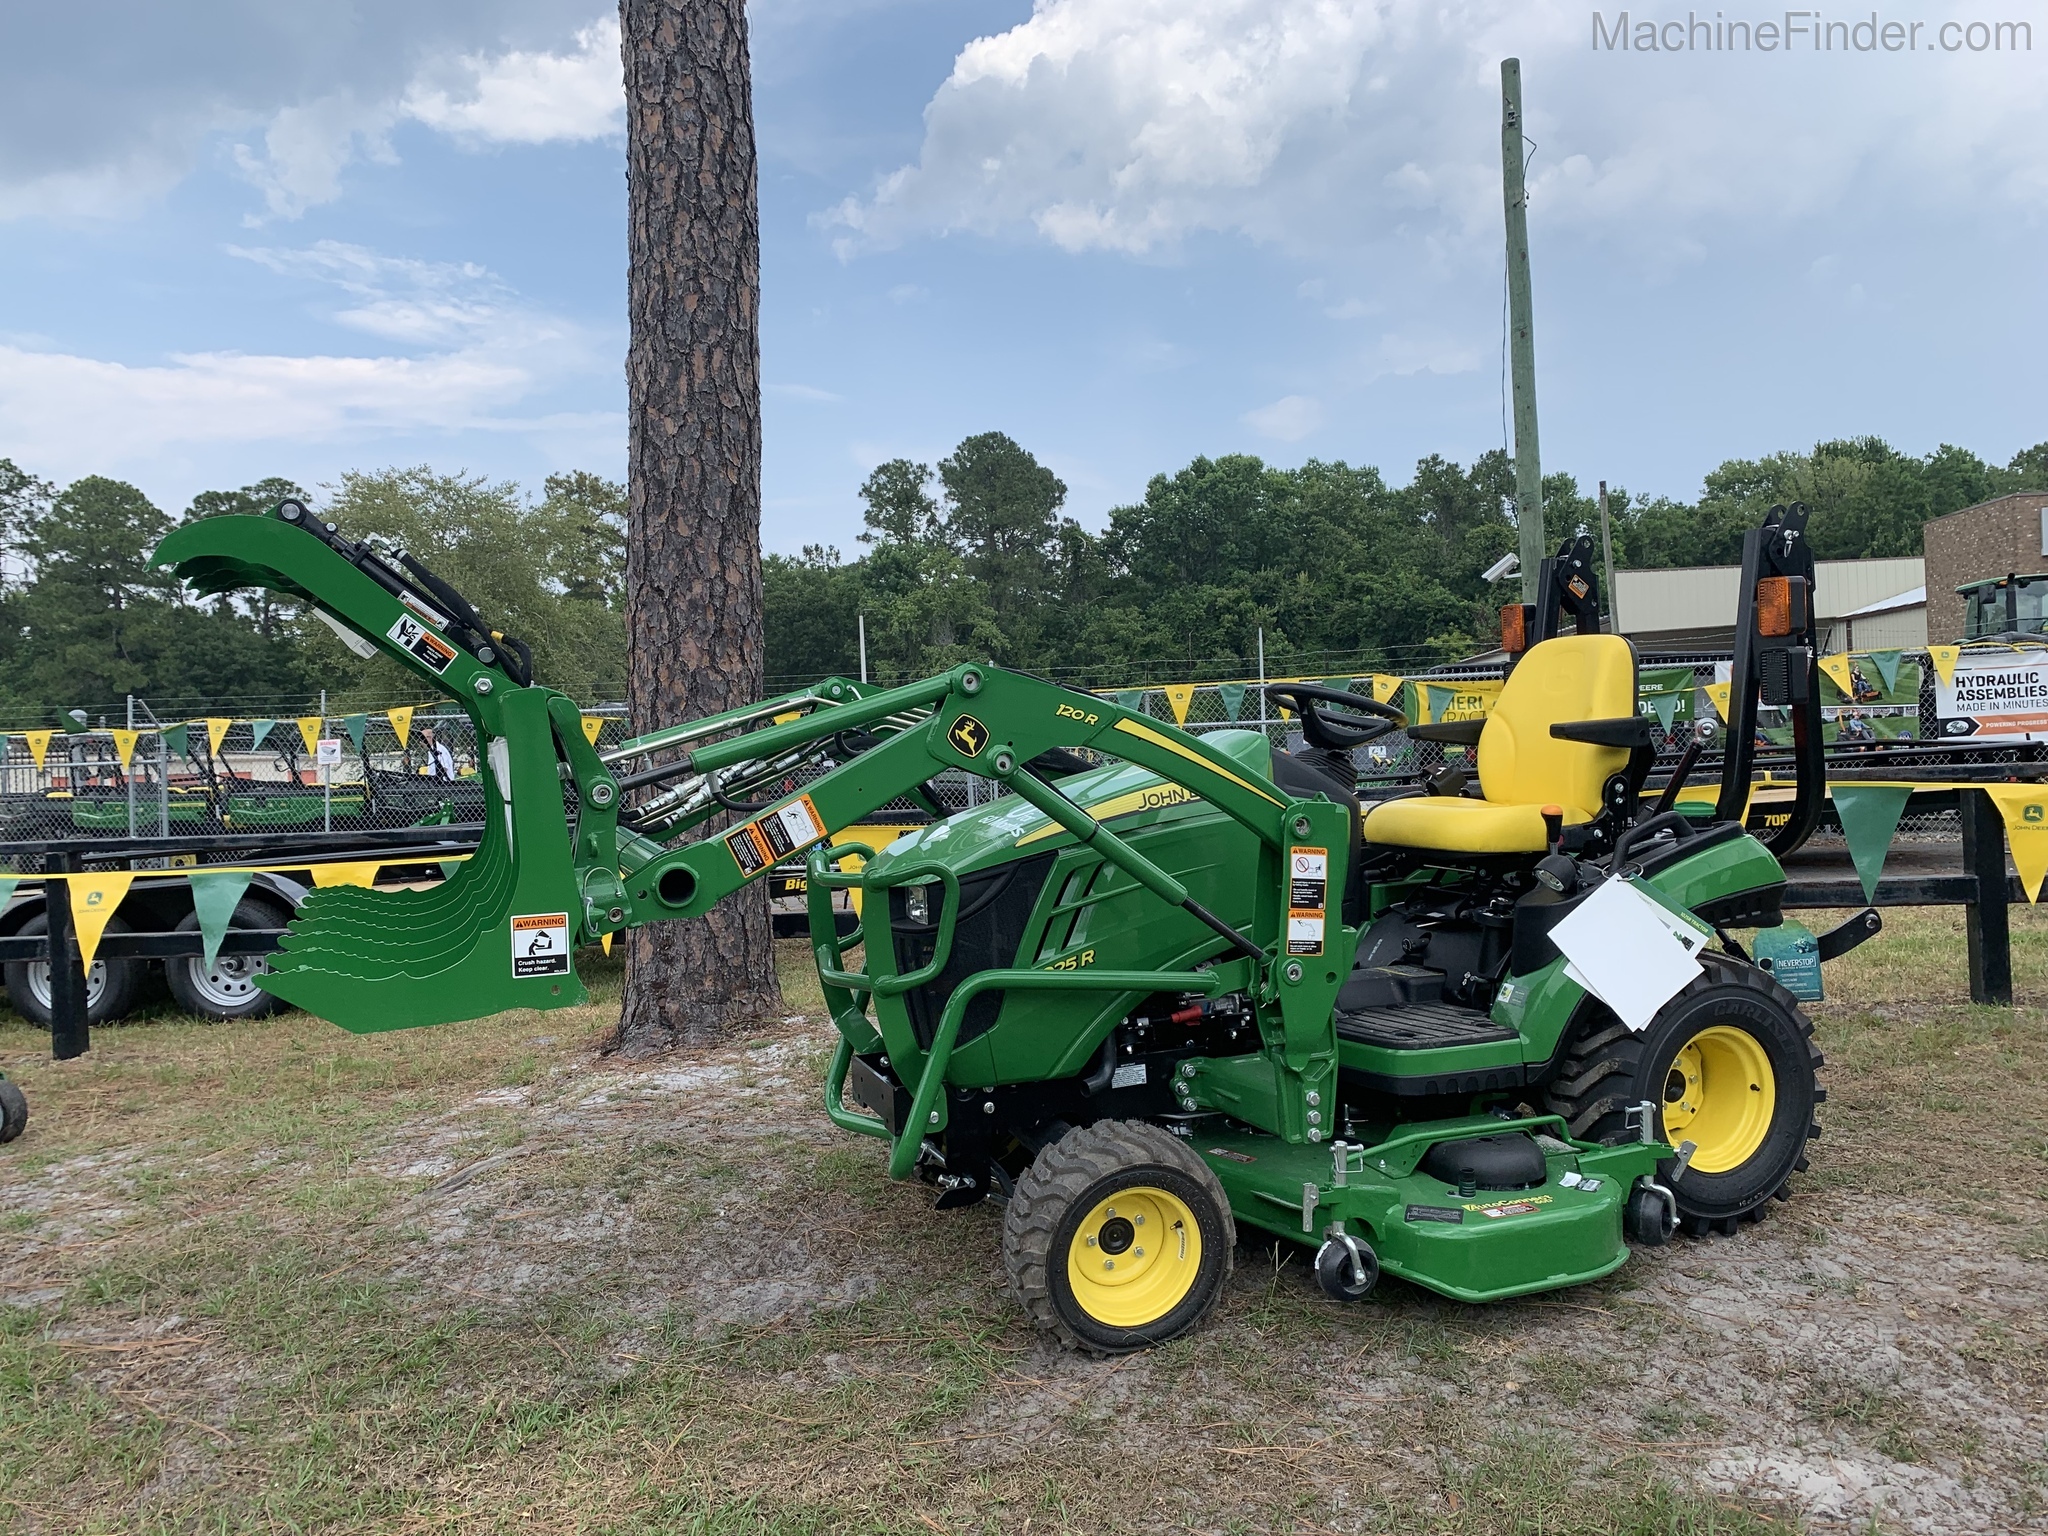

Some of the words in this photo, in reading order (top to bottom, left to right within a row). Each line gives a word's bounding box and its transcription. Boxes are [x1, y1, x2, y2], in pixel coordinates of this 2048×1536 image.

[429, 638, 452, 657] WARNING
[1956, 672, 2039, 688] HYDRAULIC
[1956, 685, 2047, 701] ASSEMBLIES
[1957, 702, 1986, 712] MADE
[1990, 702, 2000, 710] IN
[2003, 698, 2048, 709] MINUTES
[1138, 788, 1187, 809] JOHN
[807, 805, 823, 832] WARNING
[753, 835, 770, 862] WARNING
[523, 918, 564, 927] WARNING
[1081, 949, 1095, 967] R
[1778, 958, 1814, 967] NEVERSTOP
[1469, 1195, 1553, 1211] AutoConnect
